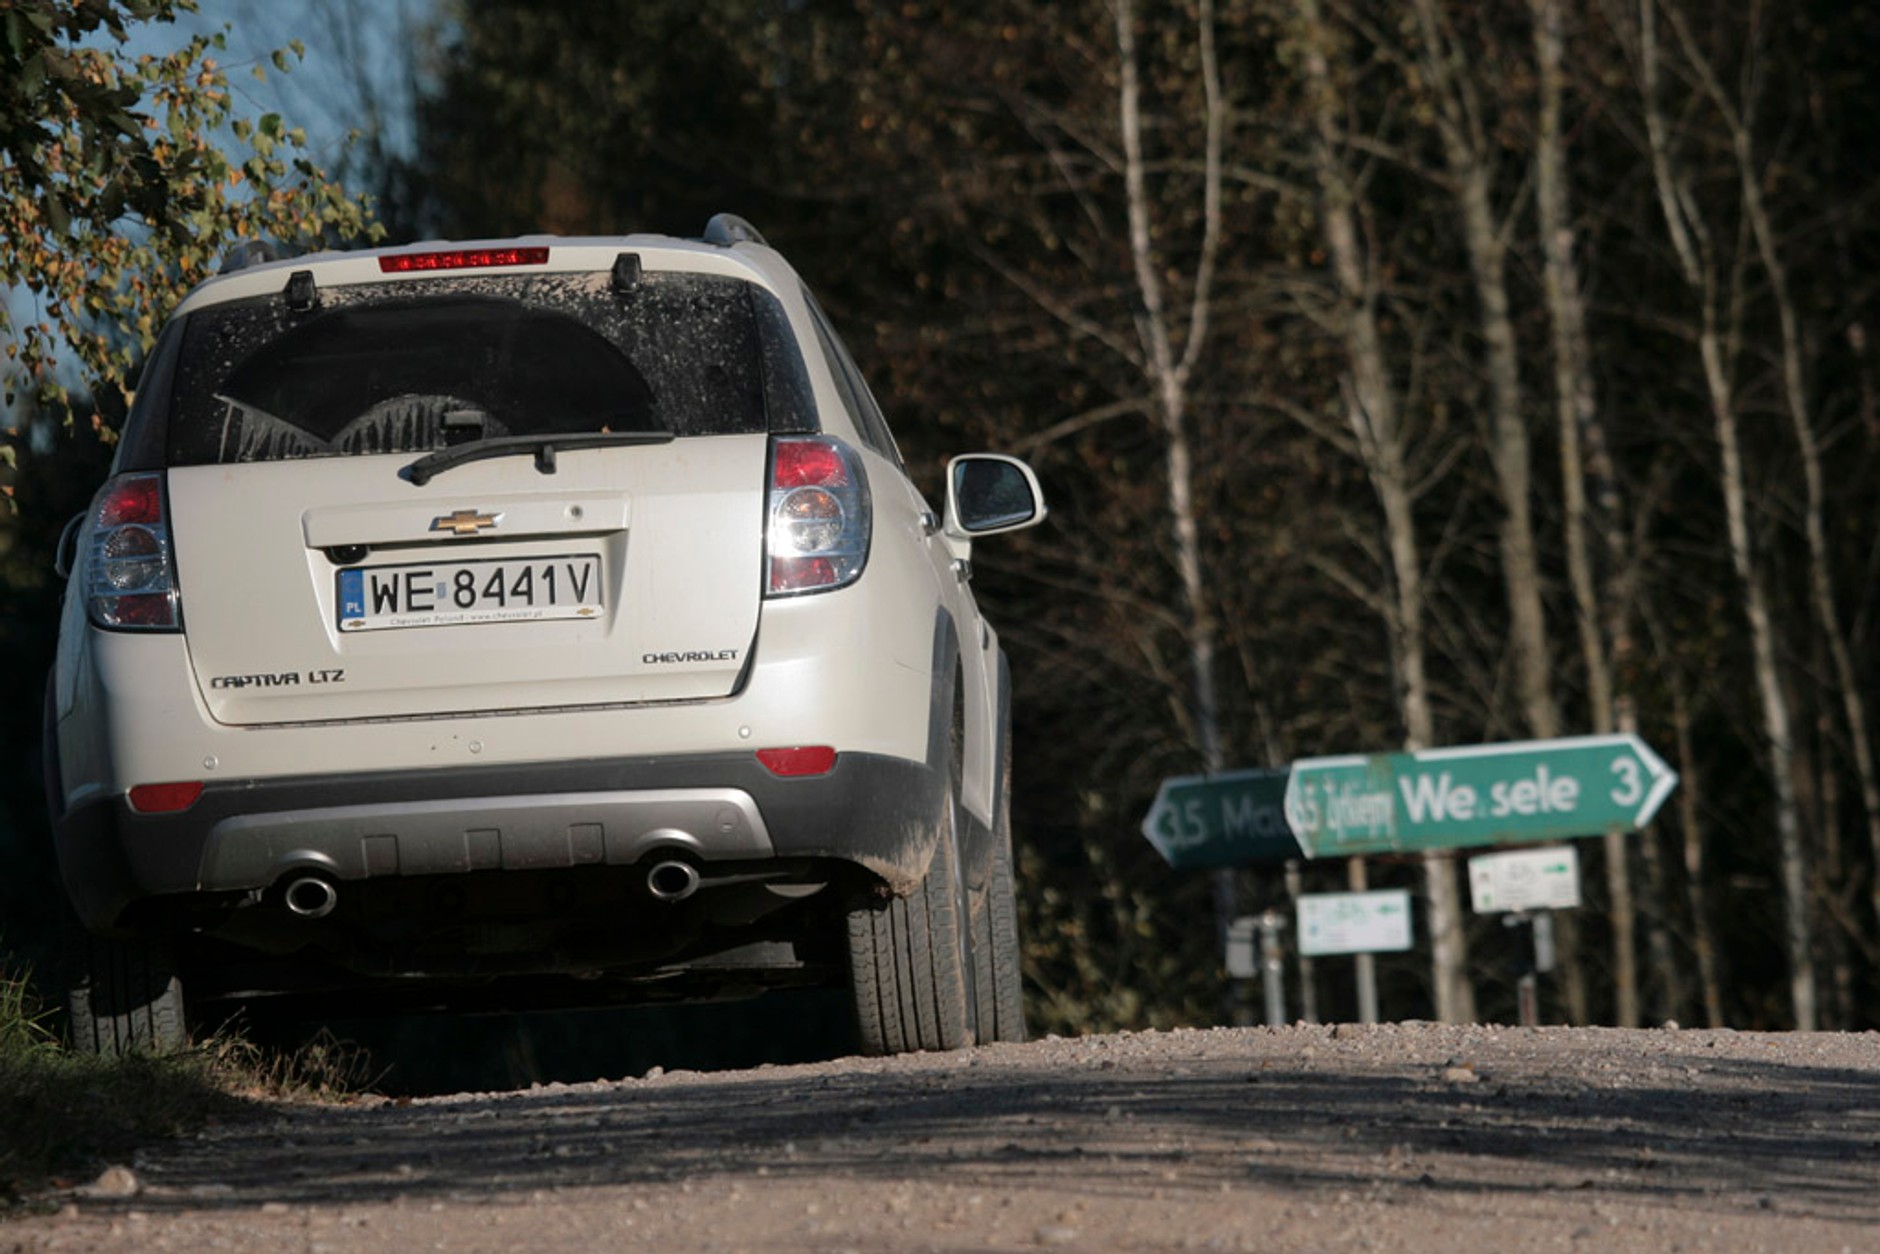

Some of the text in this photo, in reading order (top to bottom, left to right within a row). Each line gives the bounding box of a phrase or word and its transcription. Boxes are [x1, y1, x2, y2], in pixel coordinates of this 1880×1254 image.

[371, 563, 591, 614] WE 8441V
[346, 602, 362, 613] PL
[642, 649, 738, 664] CHEVROLET
[210, 669, 345, 689] CAPTIVA LTZ
[1610, 755, 1642, 807] 3
